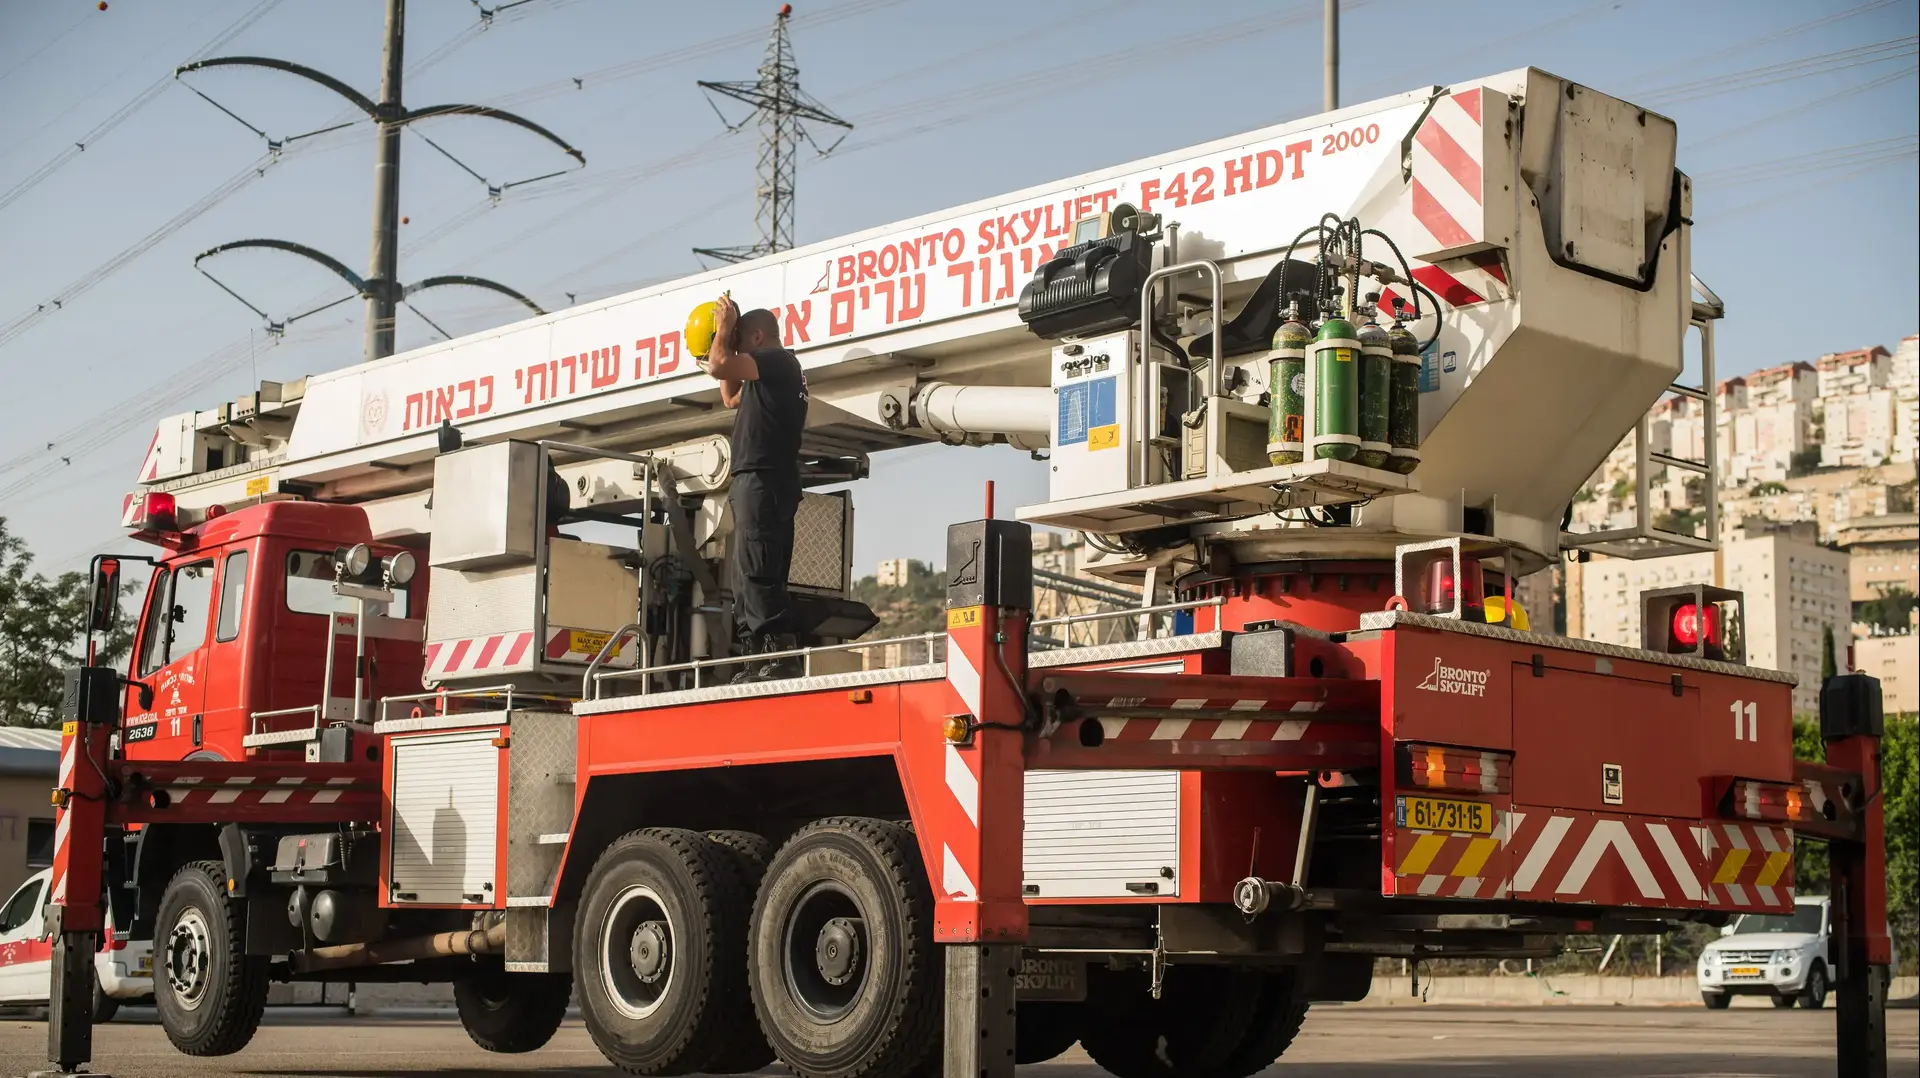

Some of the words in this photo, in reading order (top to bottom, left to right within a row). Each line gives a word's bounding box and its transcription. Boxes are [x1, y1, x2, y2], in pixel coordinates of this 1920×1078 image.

[837, 227, 966, 288] BRONTO
[978, 188, 1118, 254] SKYLIFT
[1140, 166, 1215, 213] F42
[1223, 139, 1313, 197] HDT
[1321, 123, 1380, 156] 2000
[829, 272, 926, 337] ערים
[515, 344, 621, 405] שירותי
[403, 375, 494, 431] כבאות
[1440, 666, 1487, 684] BRONTO
[1440, 680, 1486, 697] SKYLIFT
[129, 726, 154, 739] 2638
[170, 717, 180, 736] 11
[1730, 699, 1757, 742] 11
